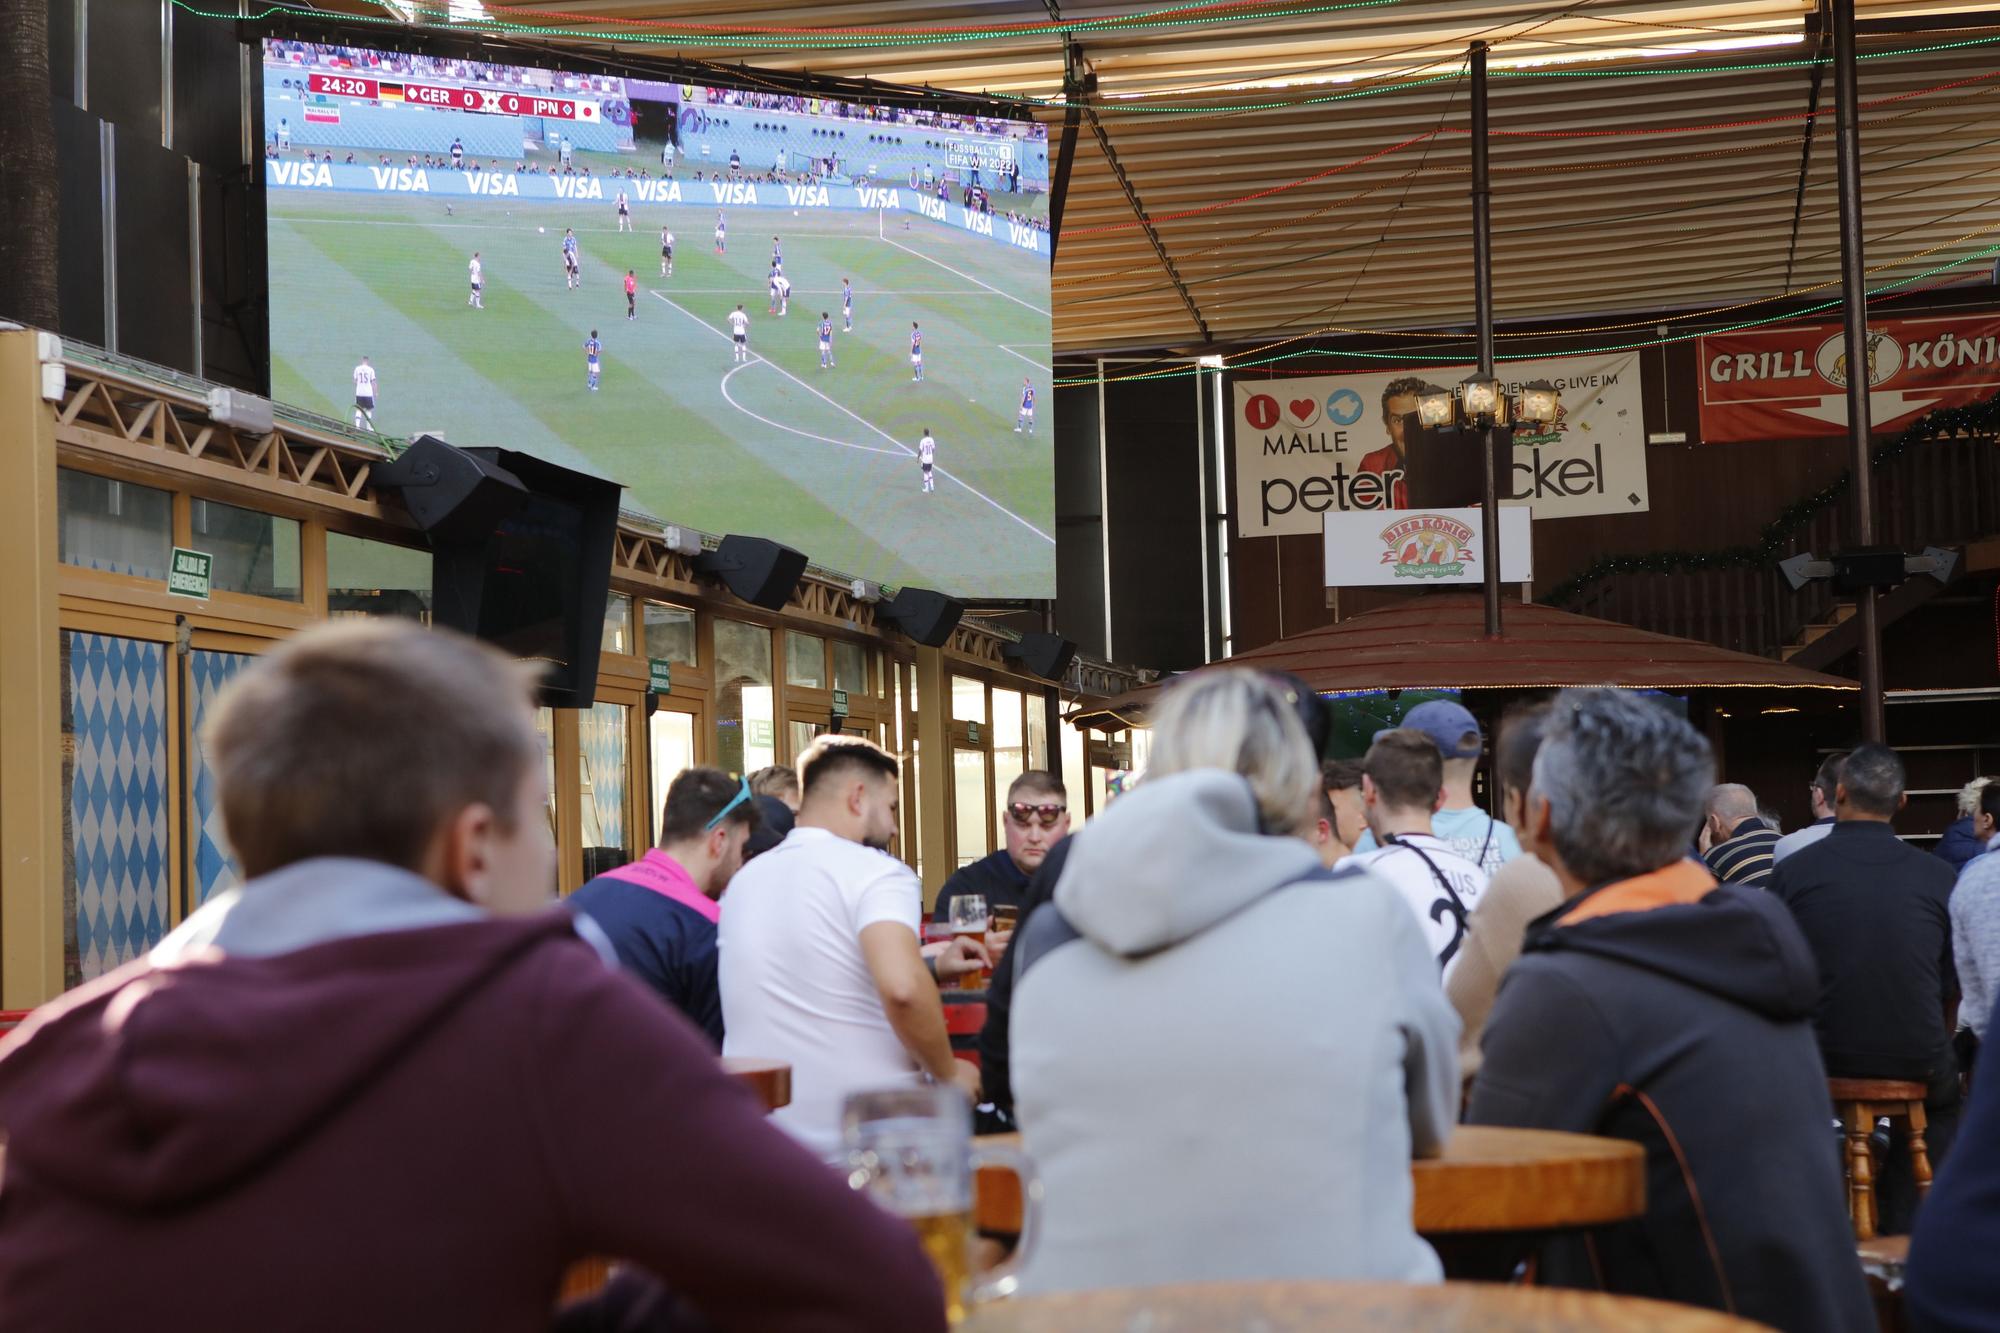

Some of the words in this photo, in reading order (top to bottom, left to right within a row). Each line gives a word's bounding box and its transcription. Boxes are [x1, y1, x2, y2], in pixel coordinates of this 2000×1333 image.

[321, 77, 366, 95] 24:20
[419, 88, 450, 103] GER
[463, 93, 474, 106] 0
[508, 98, 519, 110] 0
[533, 100, 559, 115] JPN
[268, 161, 333, 187] VISA
[949, 154, 968, 166] FIFA
[970, 157, 987, 168] WM
[989, 159, 1012, 170] 2022
[368, 166, 430, 192] VISA
[462, 171, 519, 196] VISA
[550, 176, 603, 199] VISA
[632, 179, 682, 202] VISA
[710, 182, 757, 205] VISA
[784, 185, 830, 207] VISA
[856, 188, 900, 208] VISA
[916, 193, 947, 221] VISA
[962, 208, 993, 236] VISA
[1008, 223, 1038, 251] VISA
[1710, 350, 1812, 382] GRILL
[1908, 333, 2000, 369] KÖNI
[359, 372, 369, 384] 15
[1569, 376, 1598, 389] LIVE
[1602, 373, 1619, 386] IM
[1258, 400, 1267, 424] I
[1263, 431, 1348, 456] MALLE
[1261, 462, 1403, 526] peter
[1512, 443, 1604, 500] ckel
[1384, 517, 1470, 543] BIERKÖNIG
